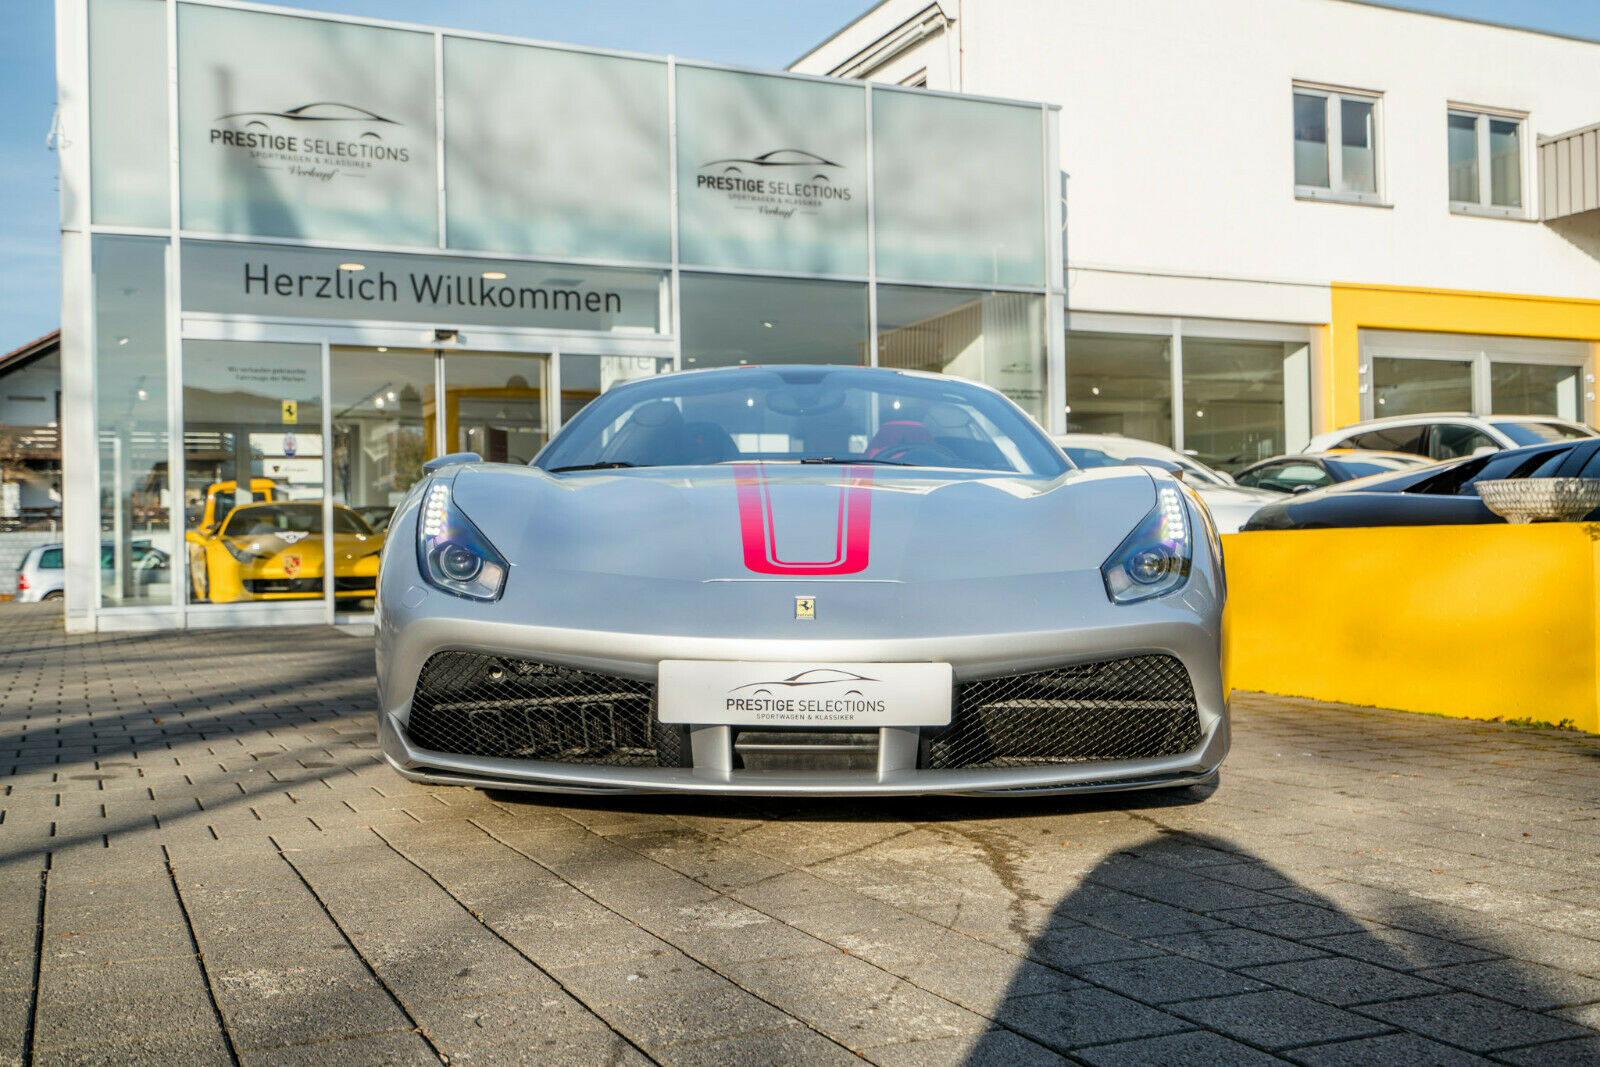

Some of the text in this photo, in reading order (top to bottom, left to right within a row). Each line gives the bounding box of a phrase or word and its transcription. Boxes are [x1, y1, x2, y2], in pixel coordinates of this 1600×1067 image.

[210, 128, 410, 163] PRESTIGE SELECTIONS
[314, 157, 321, 165] &
[696, 174, 851, 201] PRESTIGE SELECTIONS
[244, 263, 622, 314] Herzlich Willkommen
[726, 698, 886, 713] PRESTIGE SELECTIONS
[756, 713, 806, 721] SPORTWAGEN
[815, 714, 855, 722] KLASSIKER
